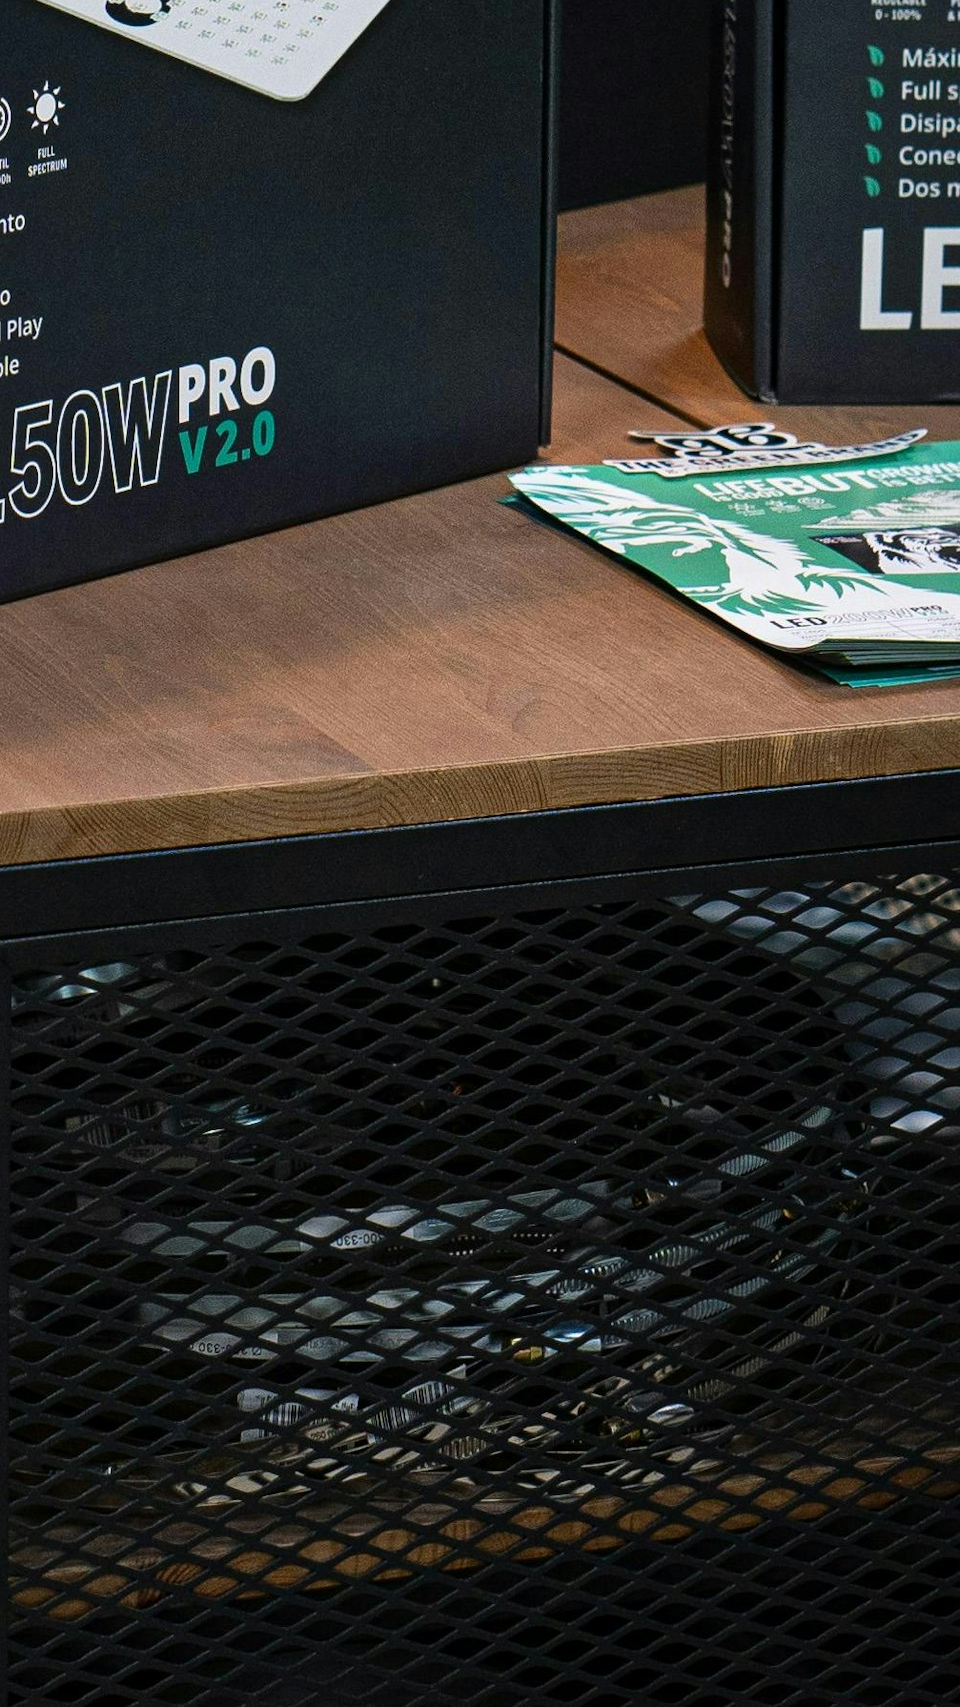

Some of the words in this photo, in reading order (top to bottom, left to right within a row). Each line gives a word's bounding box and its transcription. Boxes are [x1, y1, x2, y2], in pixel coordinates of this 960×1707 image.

[902, 47, 960, 69] Máxi
[901, 80, 941, 101] Full
[37, 146, 55, 160] FULL
[28, 158, 68, 177] SPECTRUM
[898, 179, 941, 198] Dos
[7, 316, 43, 340] Play
[686, 451, 794, 468] GREEN
[766, 471, 878, 496] BUT
